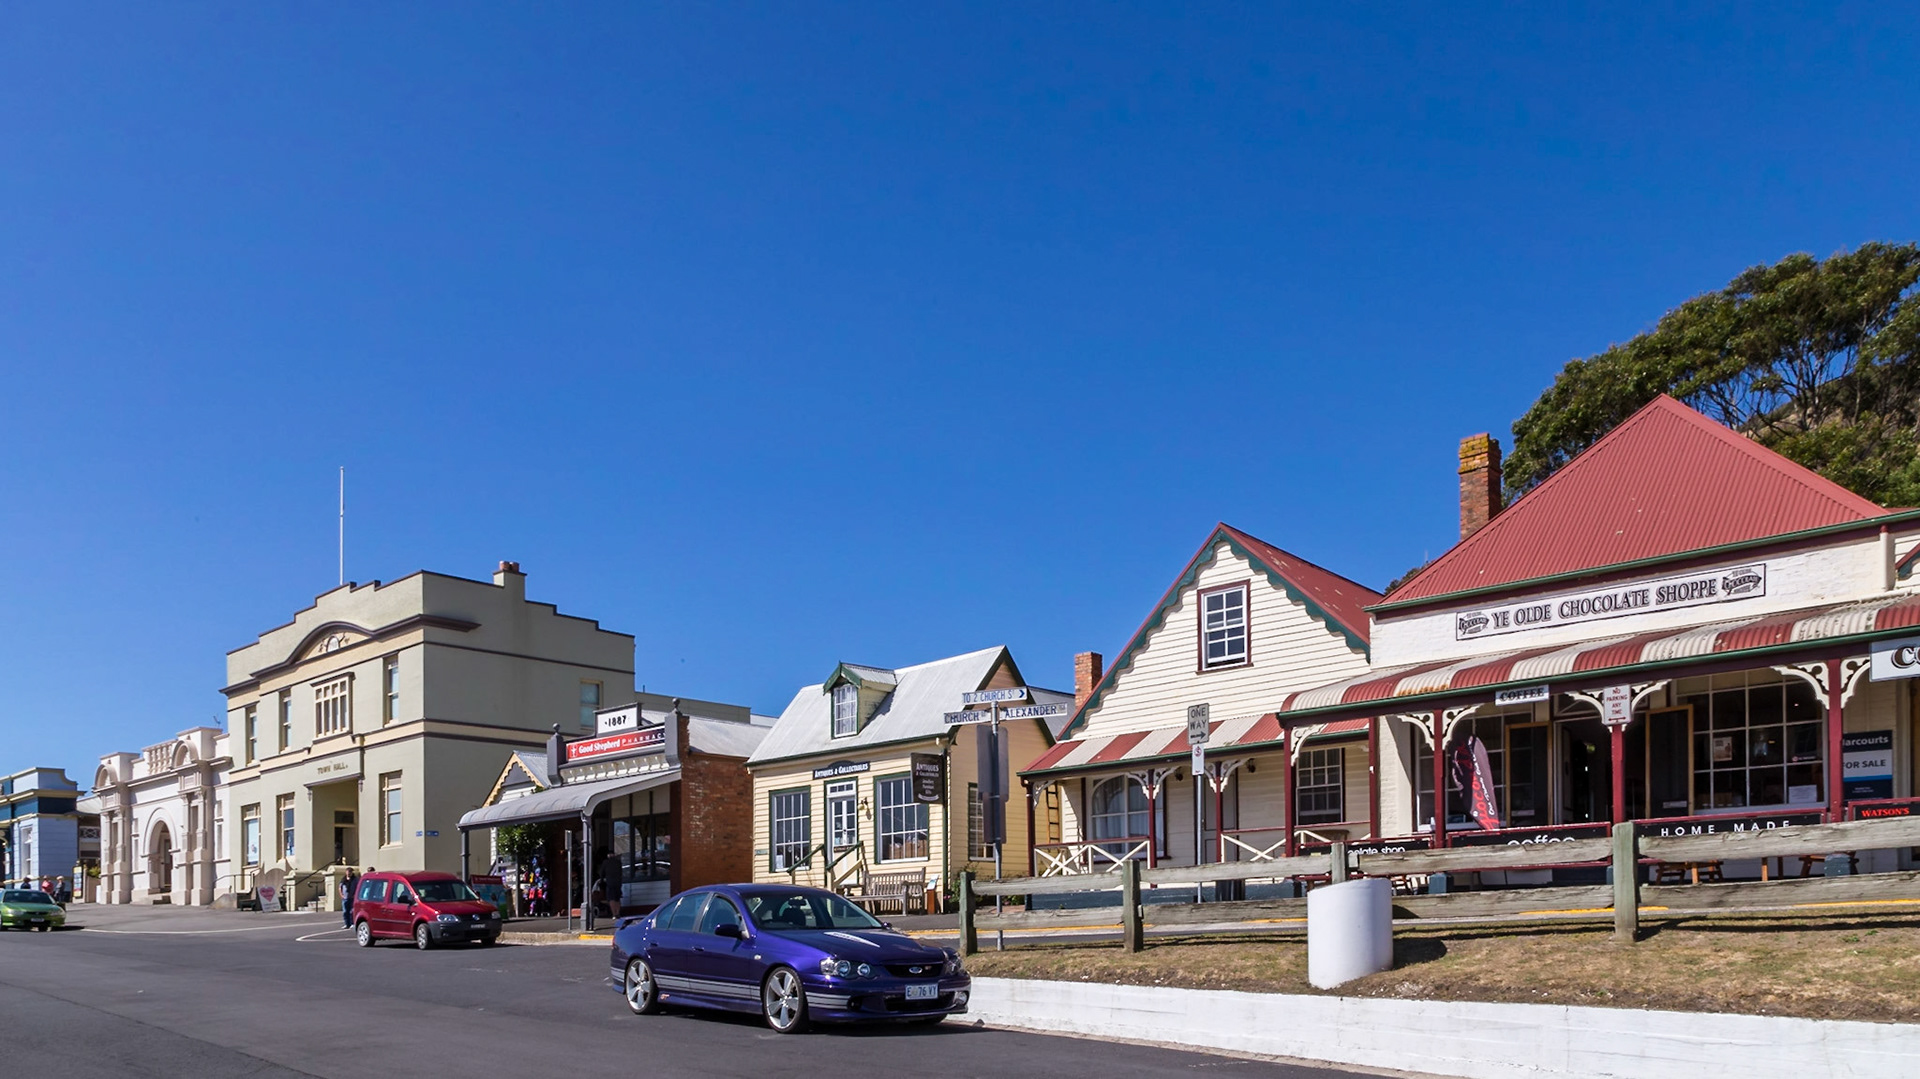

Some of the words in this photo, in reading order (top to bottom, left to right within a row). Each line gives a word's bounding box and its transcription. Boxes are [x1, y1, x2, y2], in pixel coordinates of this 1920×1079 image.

[1491, 611, 1510, 629] YE
[1513, 604, 1552, 626] OLDE
[1558, 588, 1650, 619] CHOCOLATE
[1655, 578, 1718, 606] SHOPPE
[962, 693, 971, 704] TO
[973, 694, 978, 703] 2
[980, 691, 1005, 702] CHURCH
[1500, 687, 1545, 702] COFFEE
[1005, 704, 1057, 718] ALEXANDER
[1191, 707, 1206, 718] ONE
[944, 712, 979, 724] CHURCH
[1190, 720, 1206, 730] WAY
[579, 743, 594, 754] Good
[594, 739, 620, 751] Shepherd
[915, 763, 939, 772] ANTIQUES
[1843, 761, 1860, 769] OR
[1862, 759, 1887, 768] SALE
[1861, 807, 1910, 818] WATSON'S
[1661, 825, 1715, 837] HOME
[1734, 820, 1790, 833] MADE
